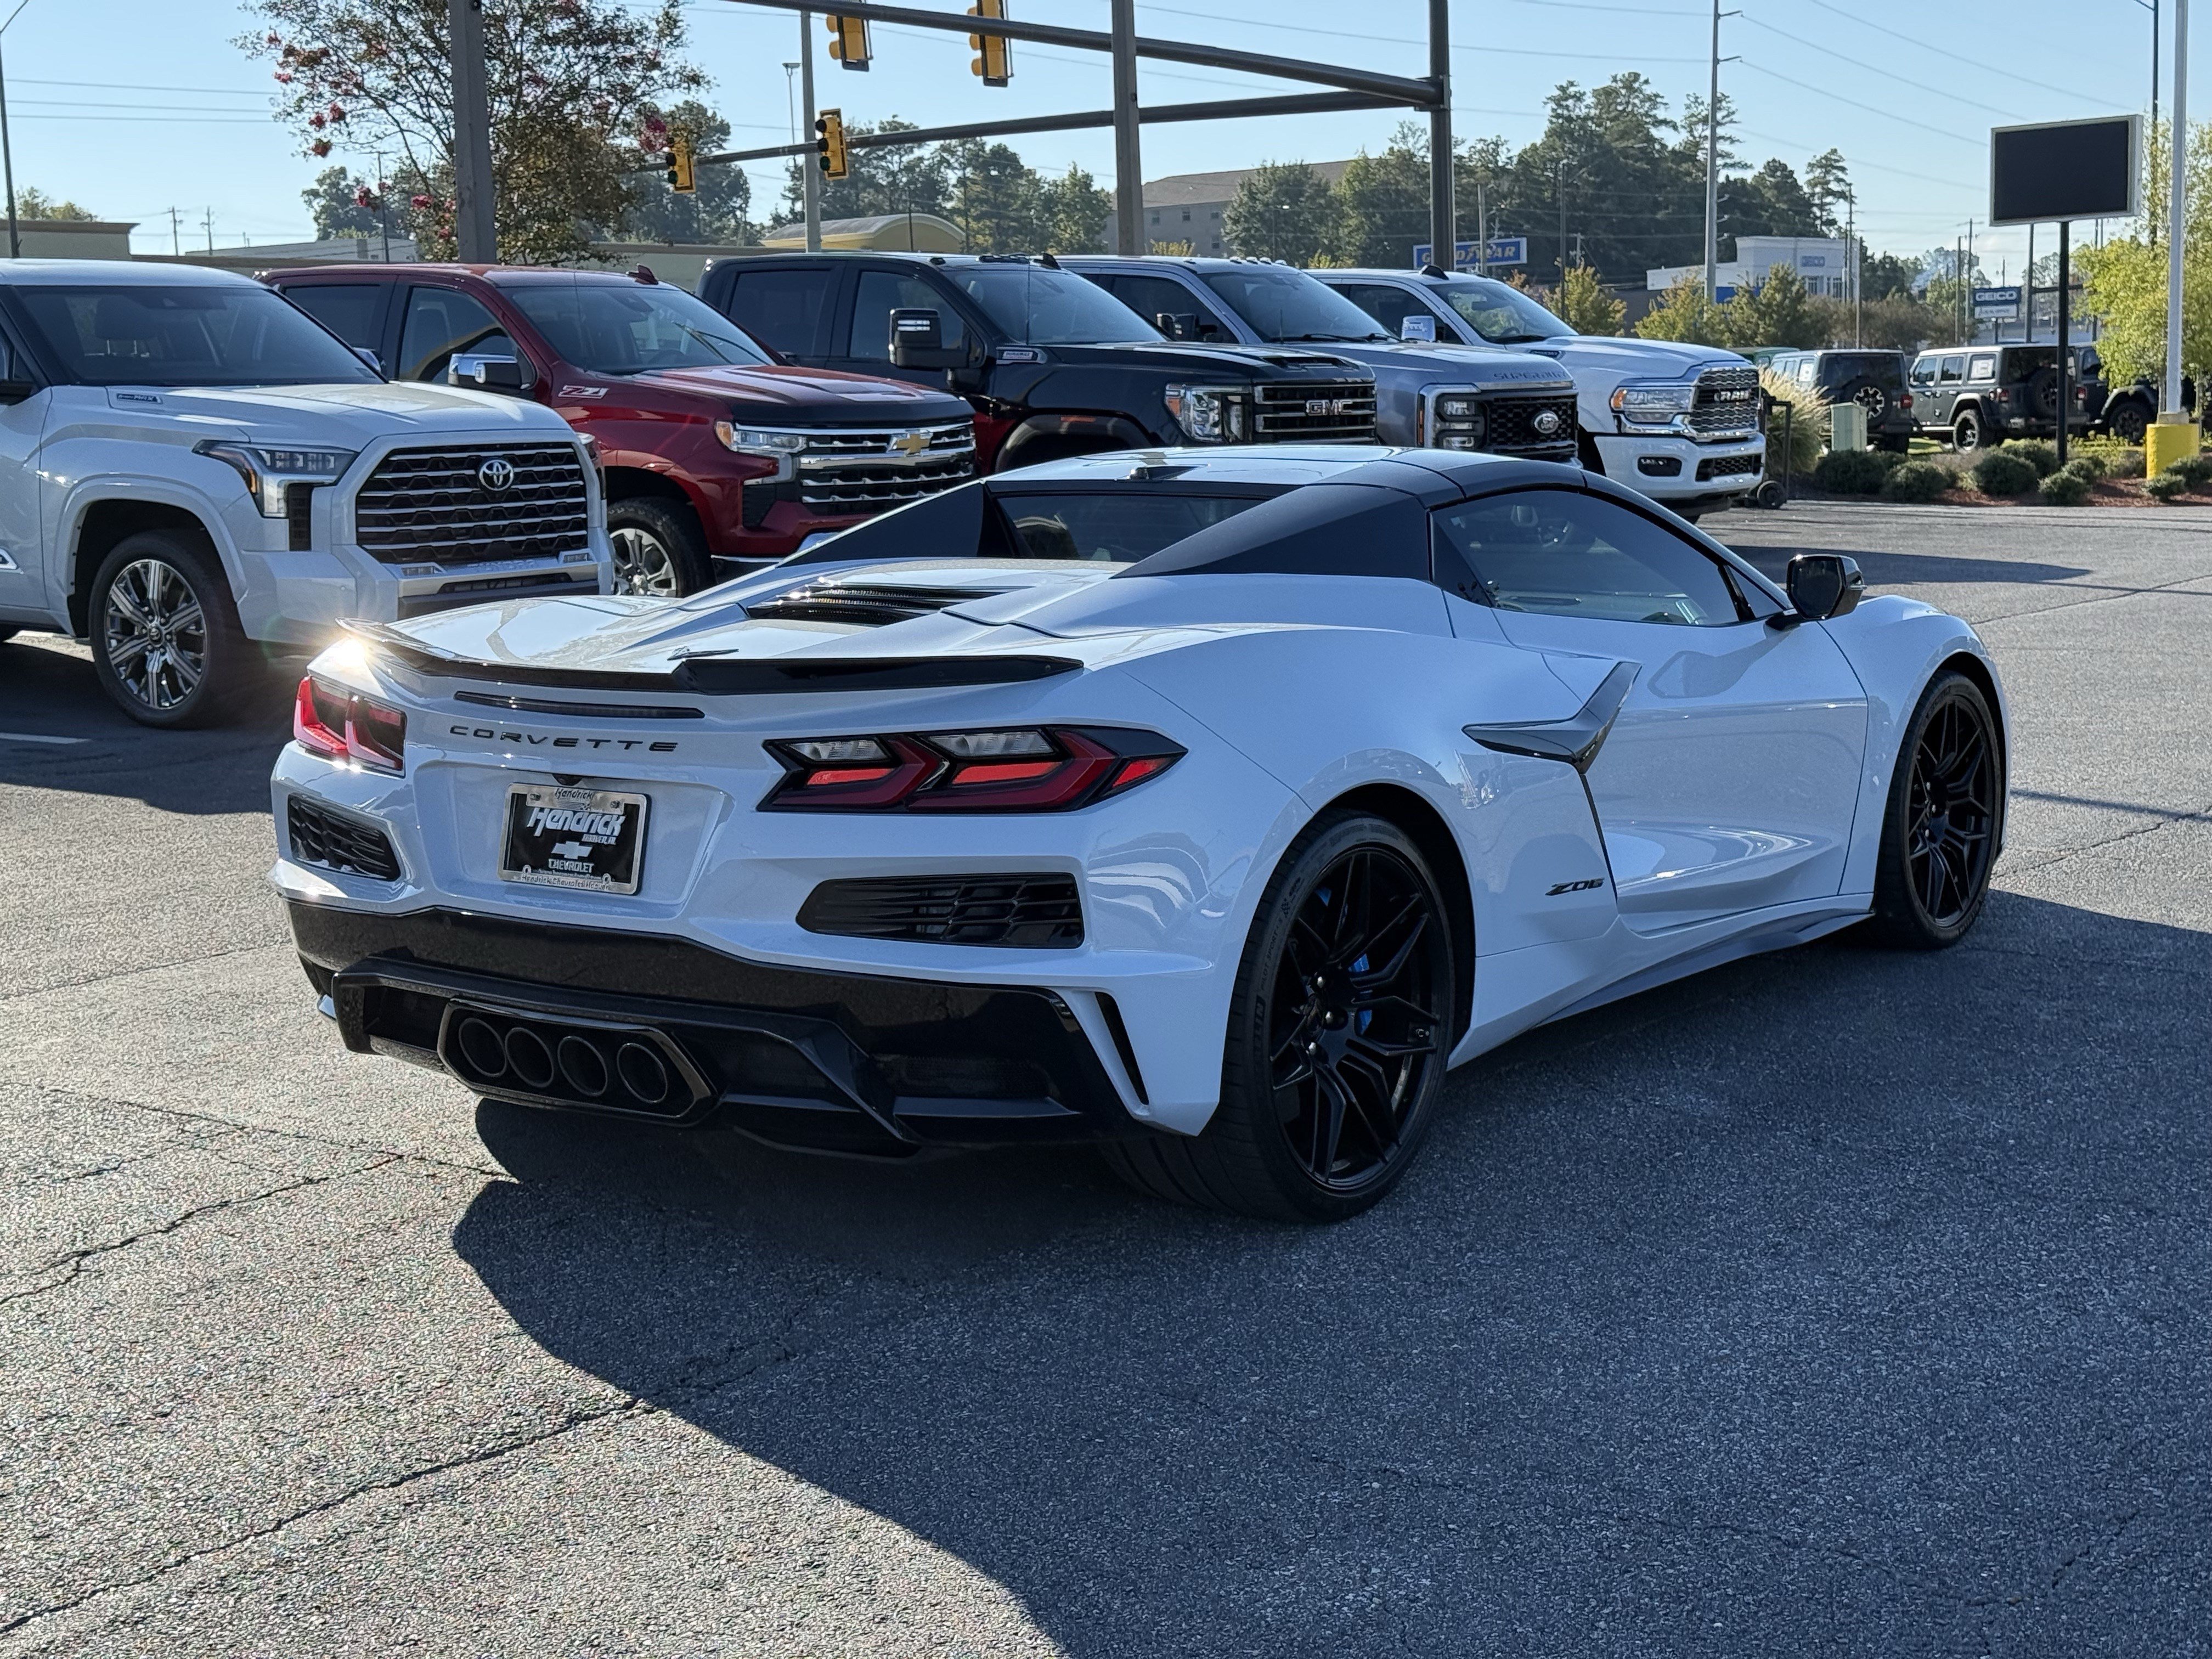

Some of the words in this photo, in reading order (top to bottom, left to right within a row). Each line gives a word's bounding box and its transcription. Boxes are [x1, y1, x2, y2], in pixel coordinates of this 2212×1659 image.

[1421, 245, 1515, 263] GDEAR
[1976, 290, 2017, 302] GEICO
[1306, 399, 1352, 416] GMC
[450, 725, 678, 752] CORVETTE
[555, 788, 592, 801] Hendrick
[527, 807, 626, 837] Hendrick
[549, 859, 594, 873] CHEVROLET
[1545, 877, 1605, 896] Z06
